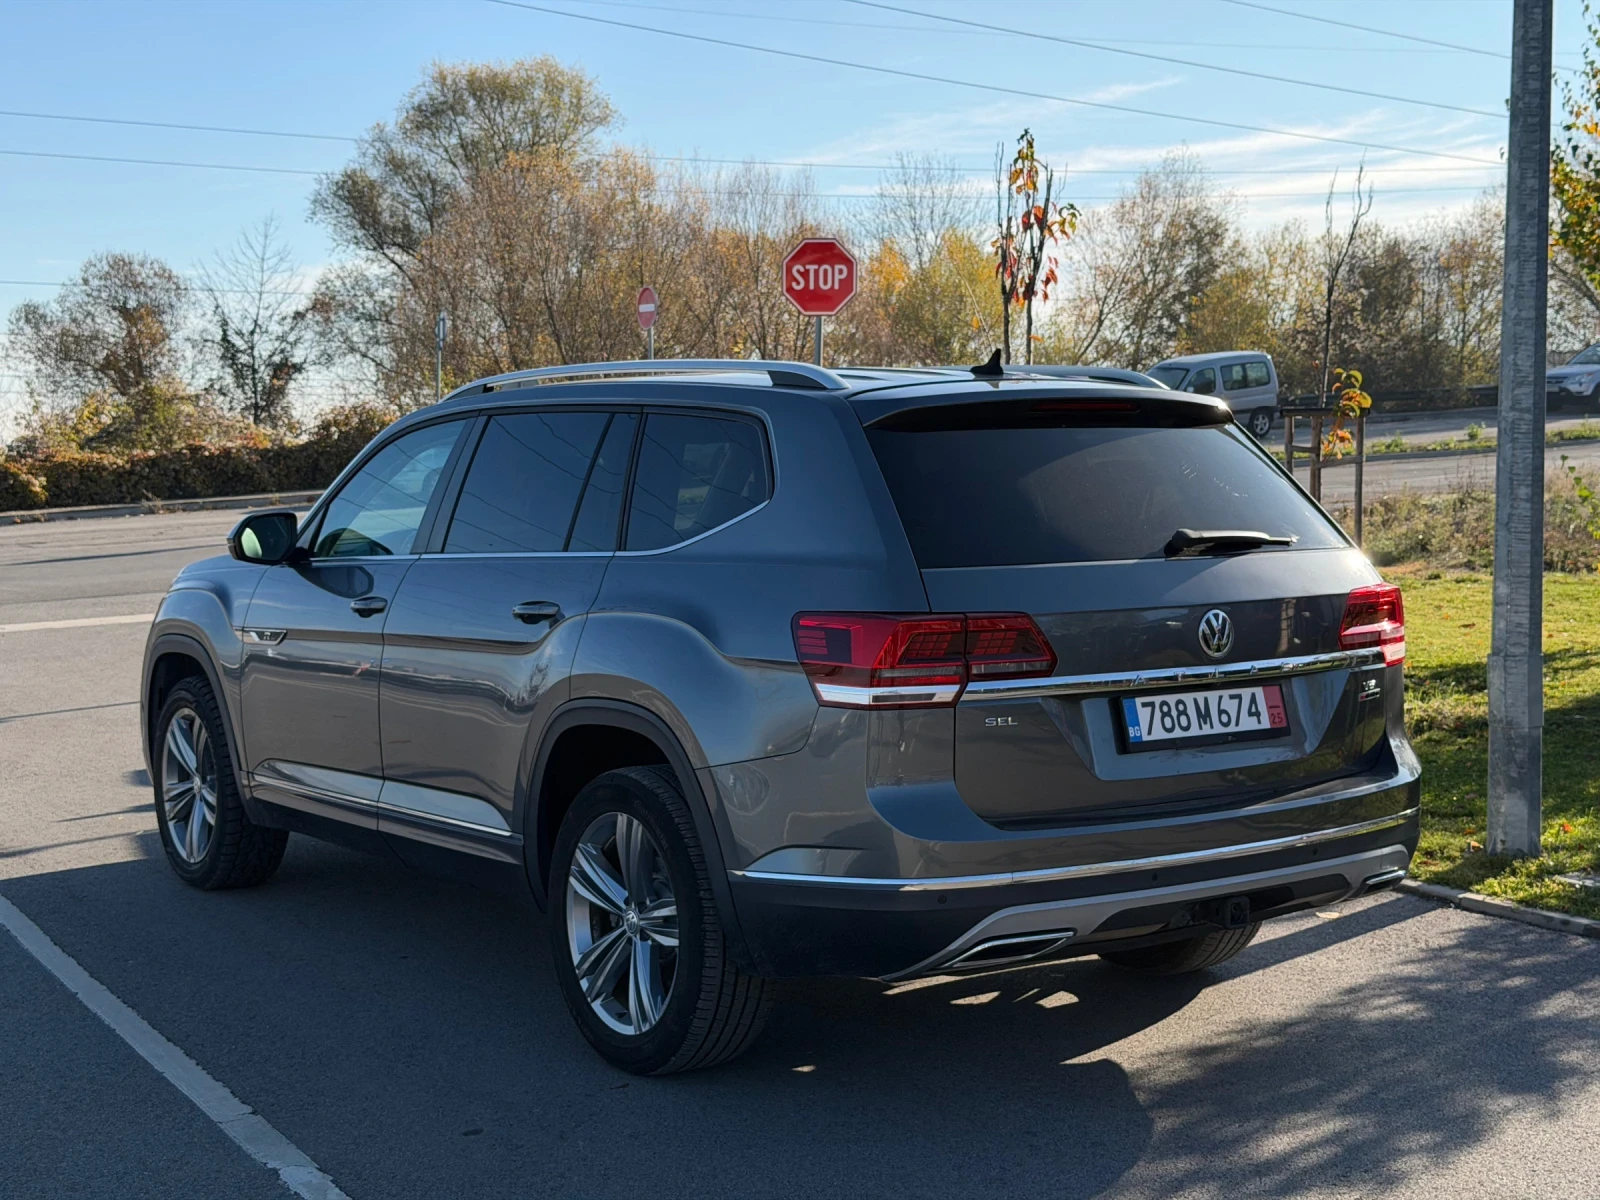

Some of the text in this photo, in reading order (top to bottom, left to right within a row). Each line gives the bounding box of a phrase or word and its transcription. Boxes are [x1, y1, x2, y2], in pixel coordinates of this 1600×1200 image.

[791, 264, 848, 291] STOP
[1141, 692, 1261, 736] 788M674
[1271, 712, 1283, 725] 25
[985, 716, 1018, 727] SEL
[1129, 726, 1141, 737] BG
